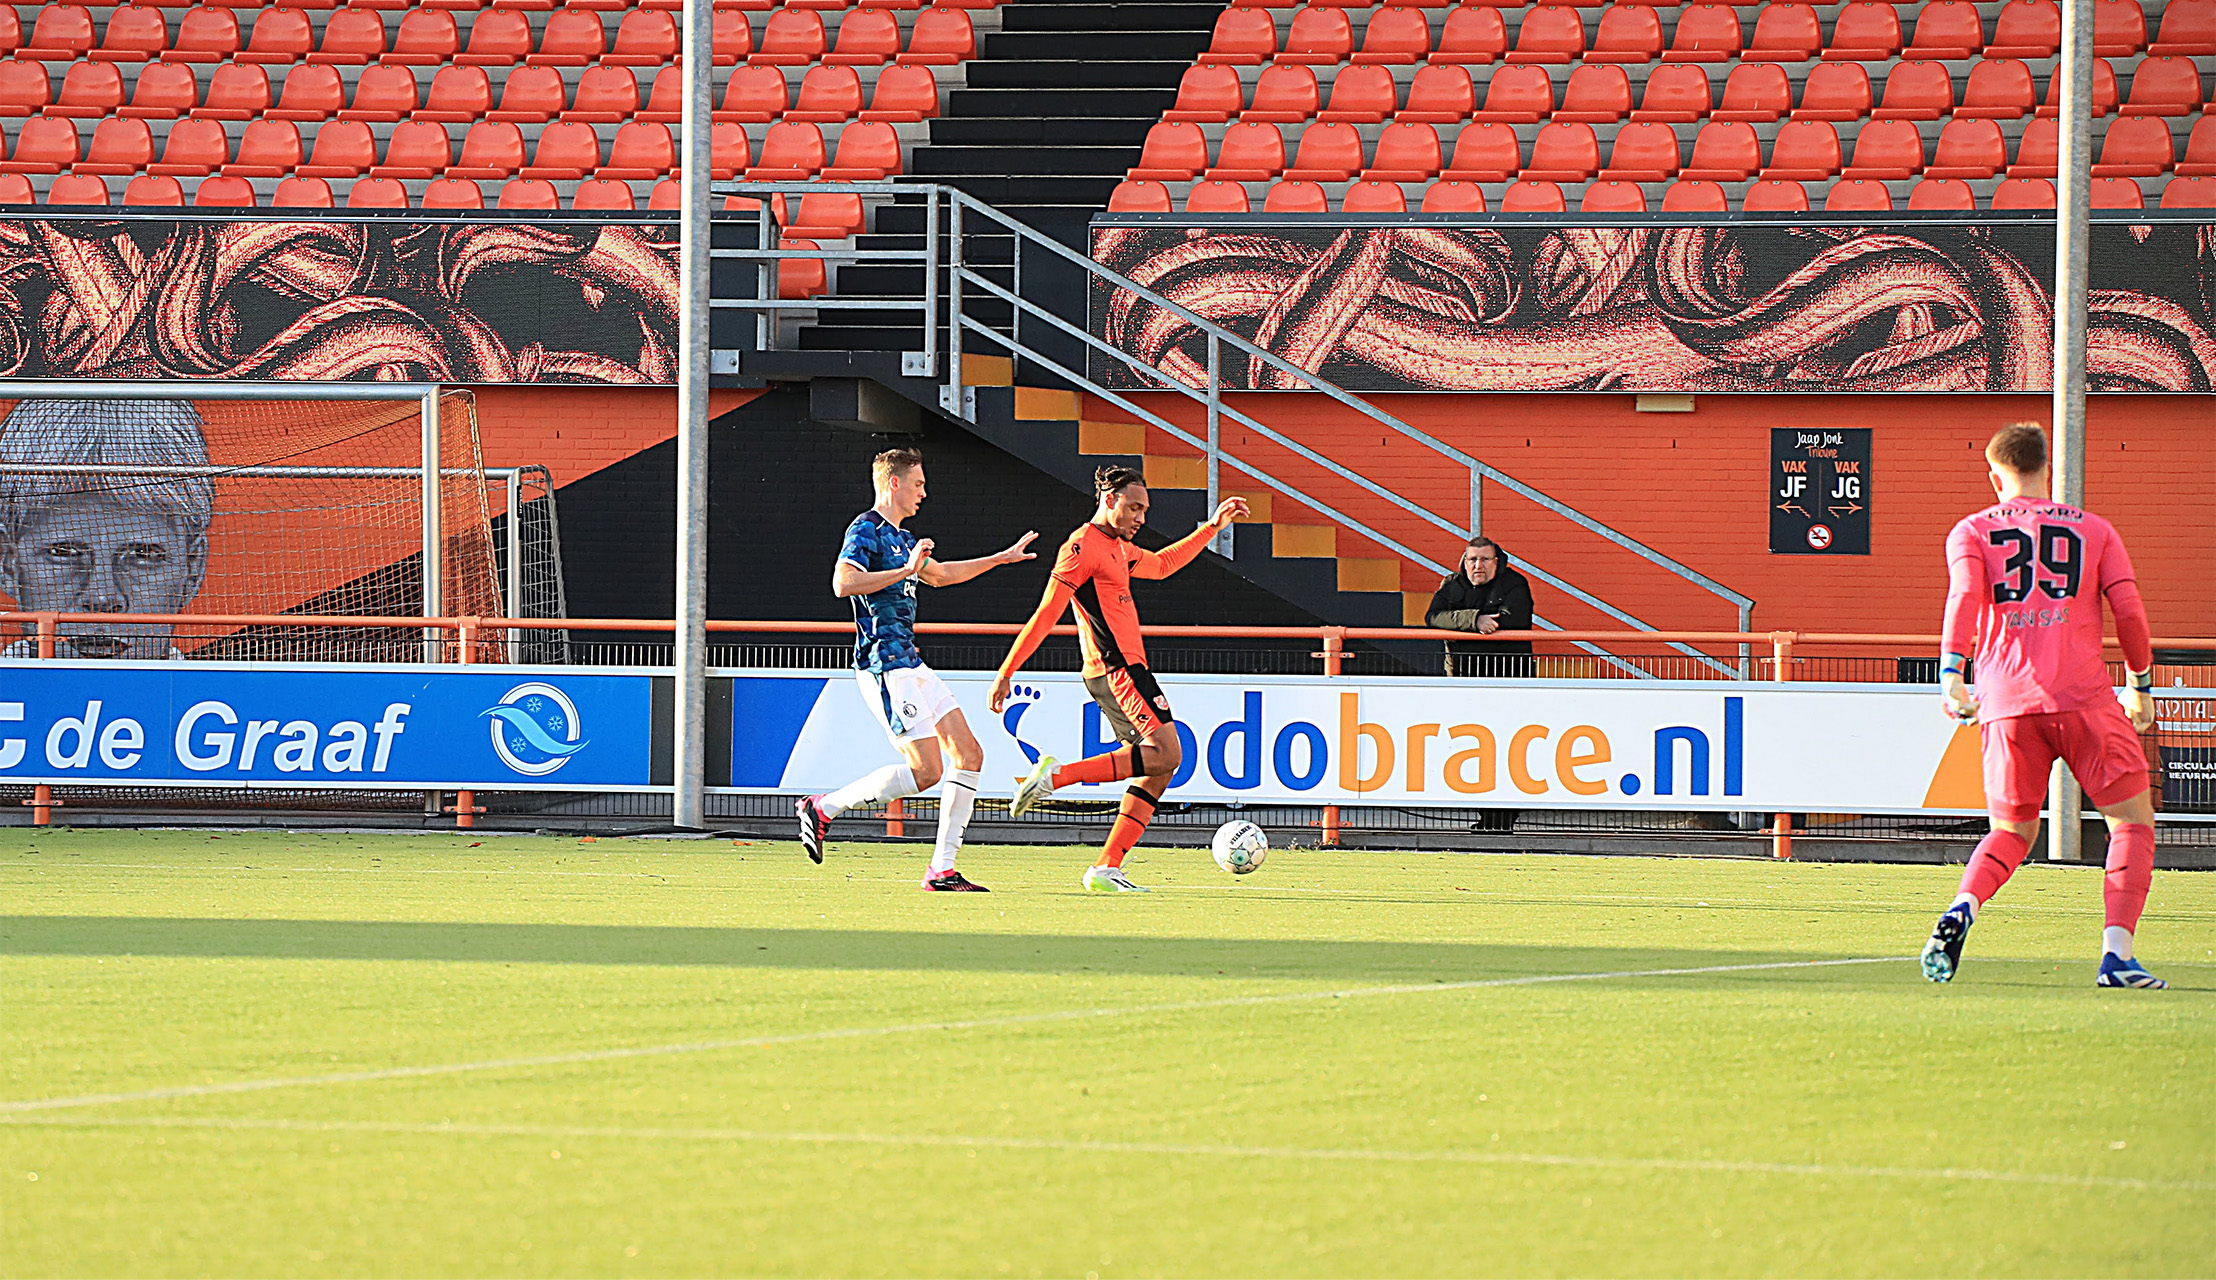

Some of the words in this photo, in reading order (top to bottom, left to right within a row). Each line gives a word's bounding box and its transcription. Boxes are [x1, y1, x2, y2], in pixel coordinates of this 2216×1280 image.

[1794, 431, 1820, 448] Jaap
[1820, 431, 1844, 448] Jonk
[1804, 446, 1839, 459] Tribune
[1781, 460, 1807, 473] VAK
[1834, 461, 1860, 474] VAK
[1779, 476, 1807, 498] JF
[1831, 476, 1860, 499] JG
[1989, 524, 2087, 604] 39
[45, 699, 146, 770] de
[174, 700, 411, 773] Graaf
